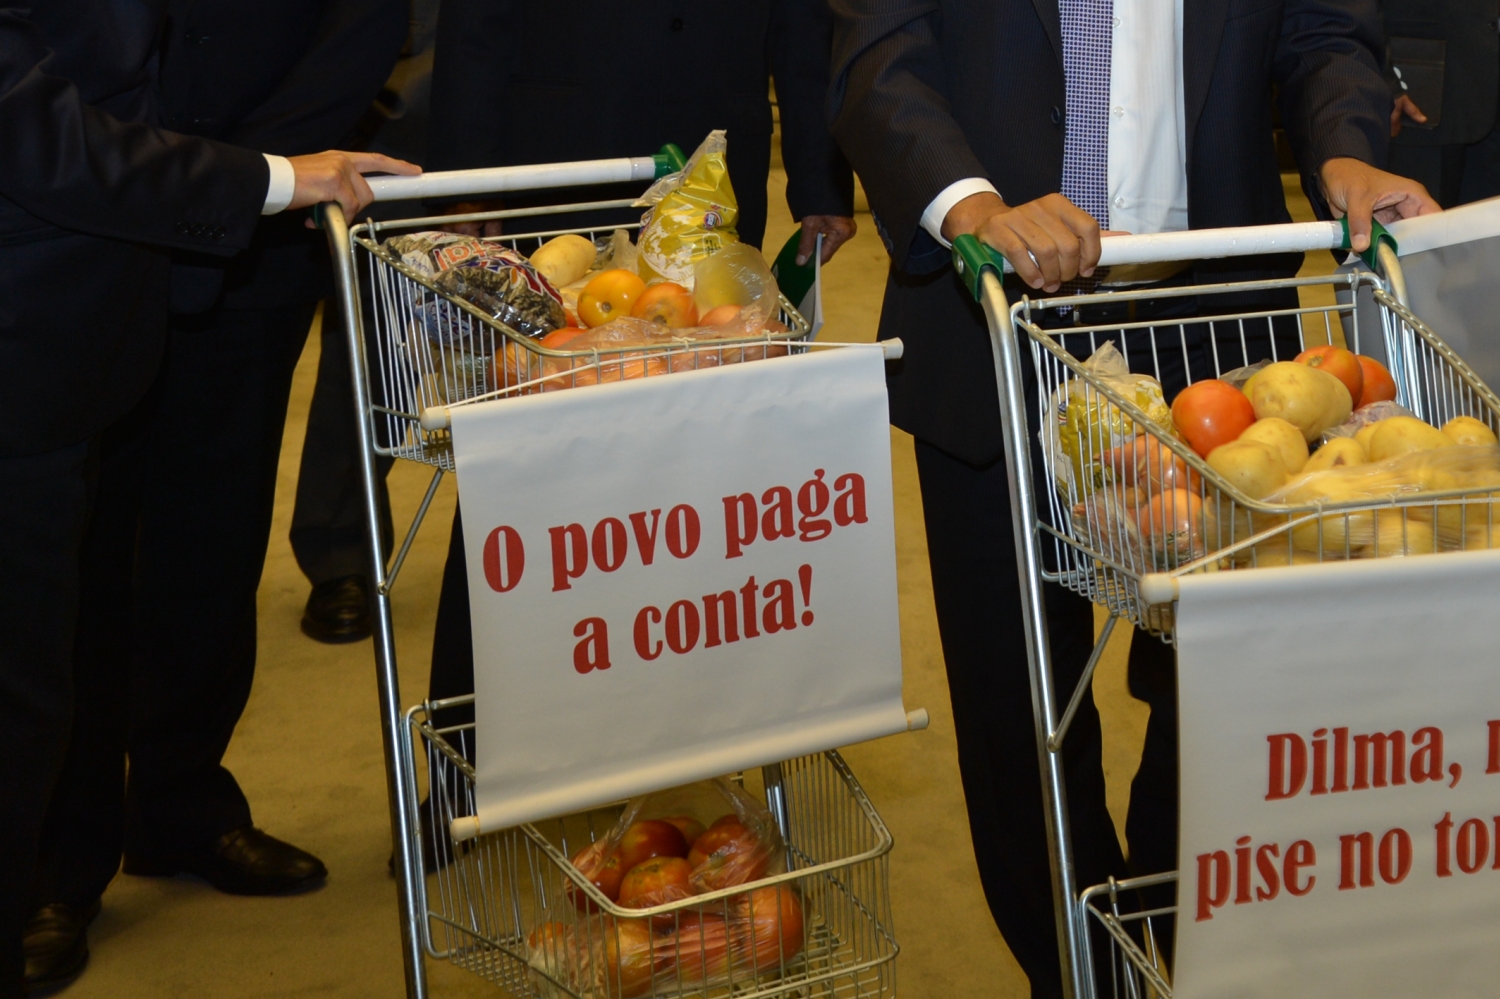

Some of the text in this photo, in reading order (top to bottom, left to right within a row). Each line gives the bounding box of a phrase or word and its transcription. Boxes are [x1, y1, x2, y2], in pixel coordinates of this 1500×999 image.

[484, 470, 867, 592] O povo paga
[574, 565, 813, 673] a conta!
[1266, 728, 1460, 799] Dilma,
[1198, 837, 1314, 920] pise
[1340, 829, 1411, 889] no
